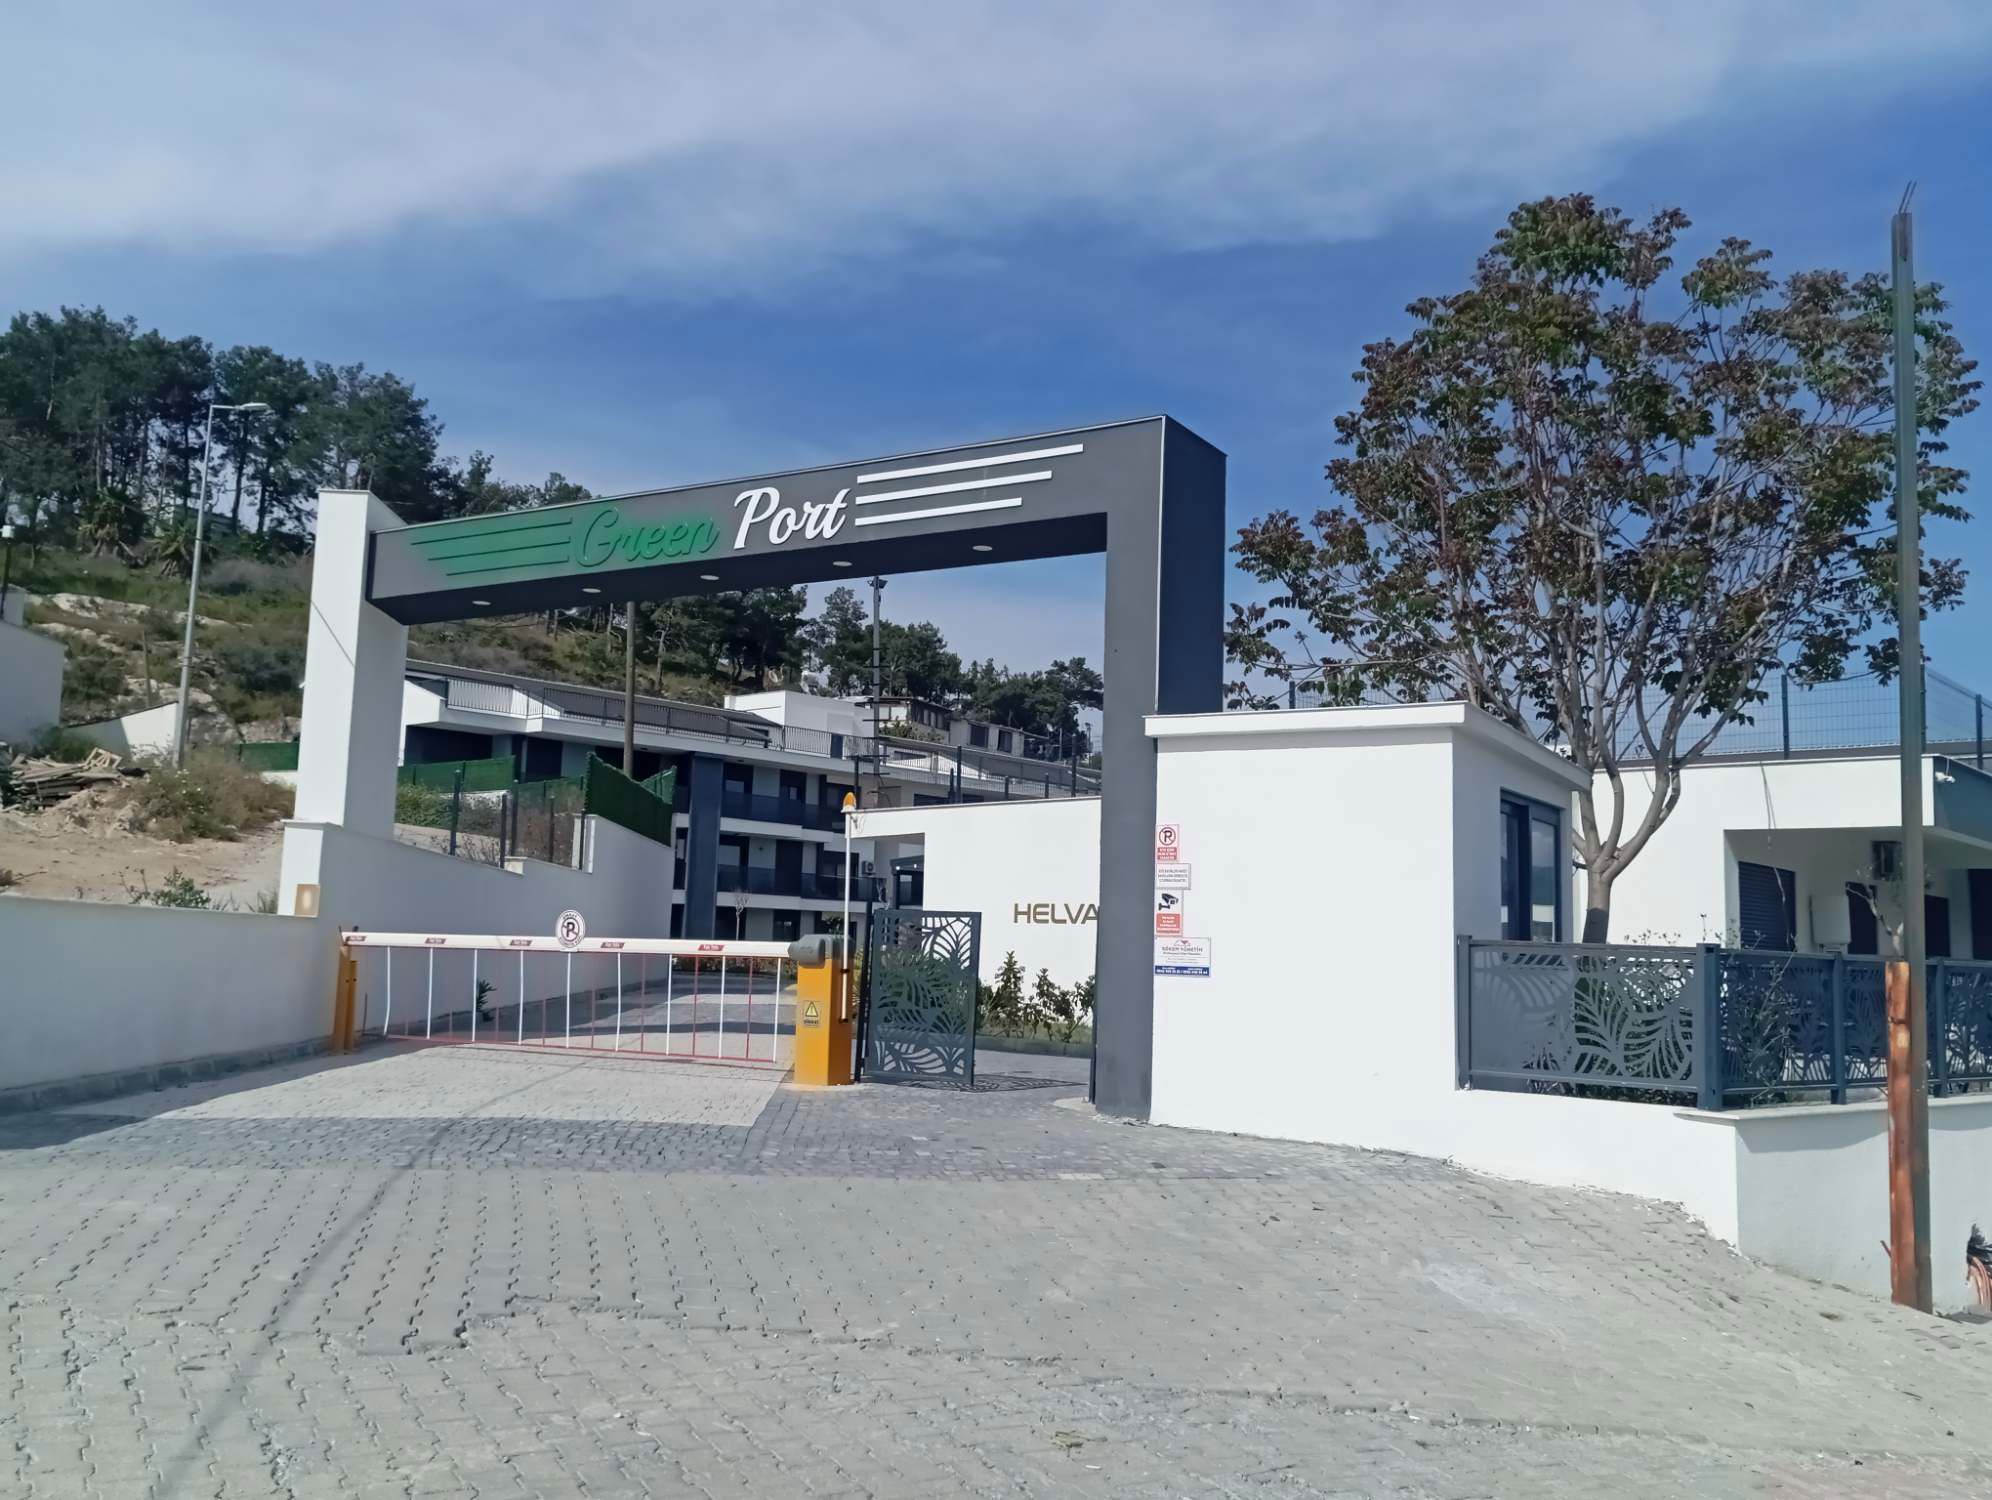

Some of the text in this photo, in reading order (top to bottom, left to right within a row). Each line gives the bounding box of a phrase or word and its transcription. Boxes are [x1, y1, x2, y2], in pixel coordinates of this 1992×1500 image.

[576, 486, 852, 567] Green Port
[1013, 903, 1099, 924] HELVA
